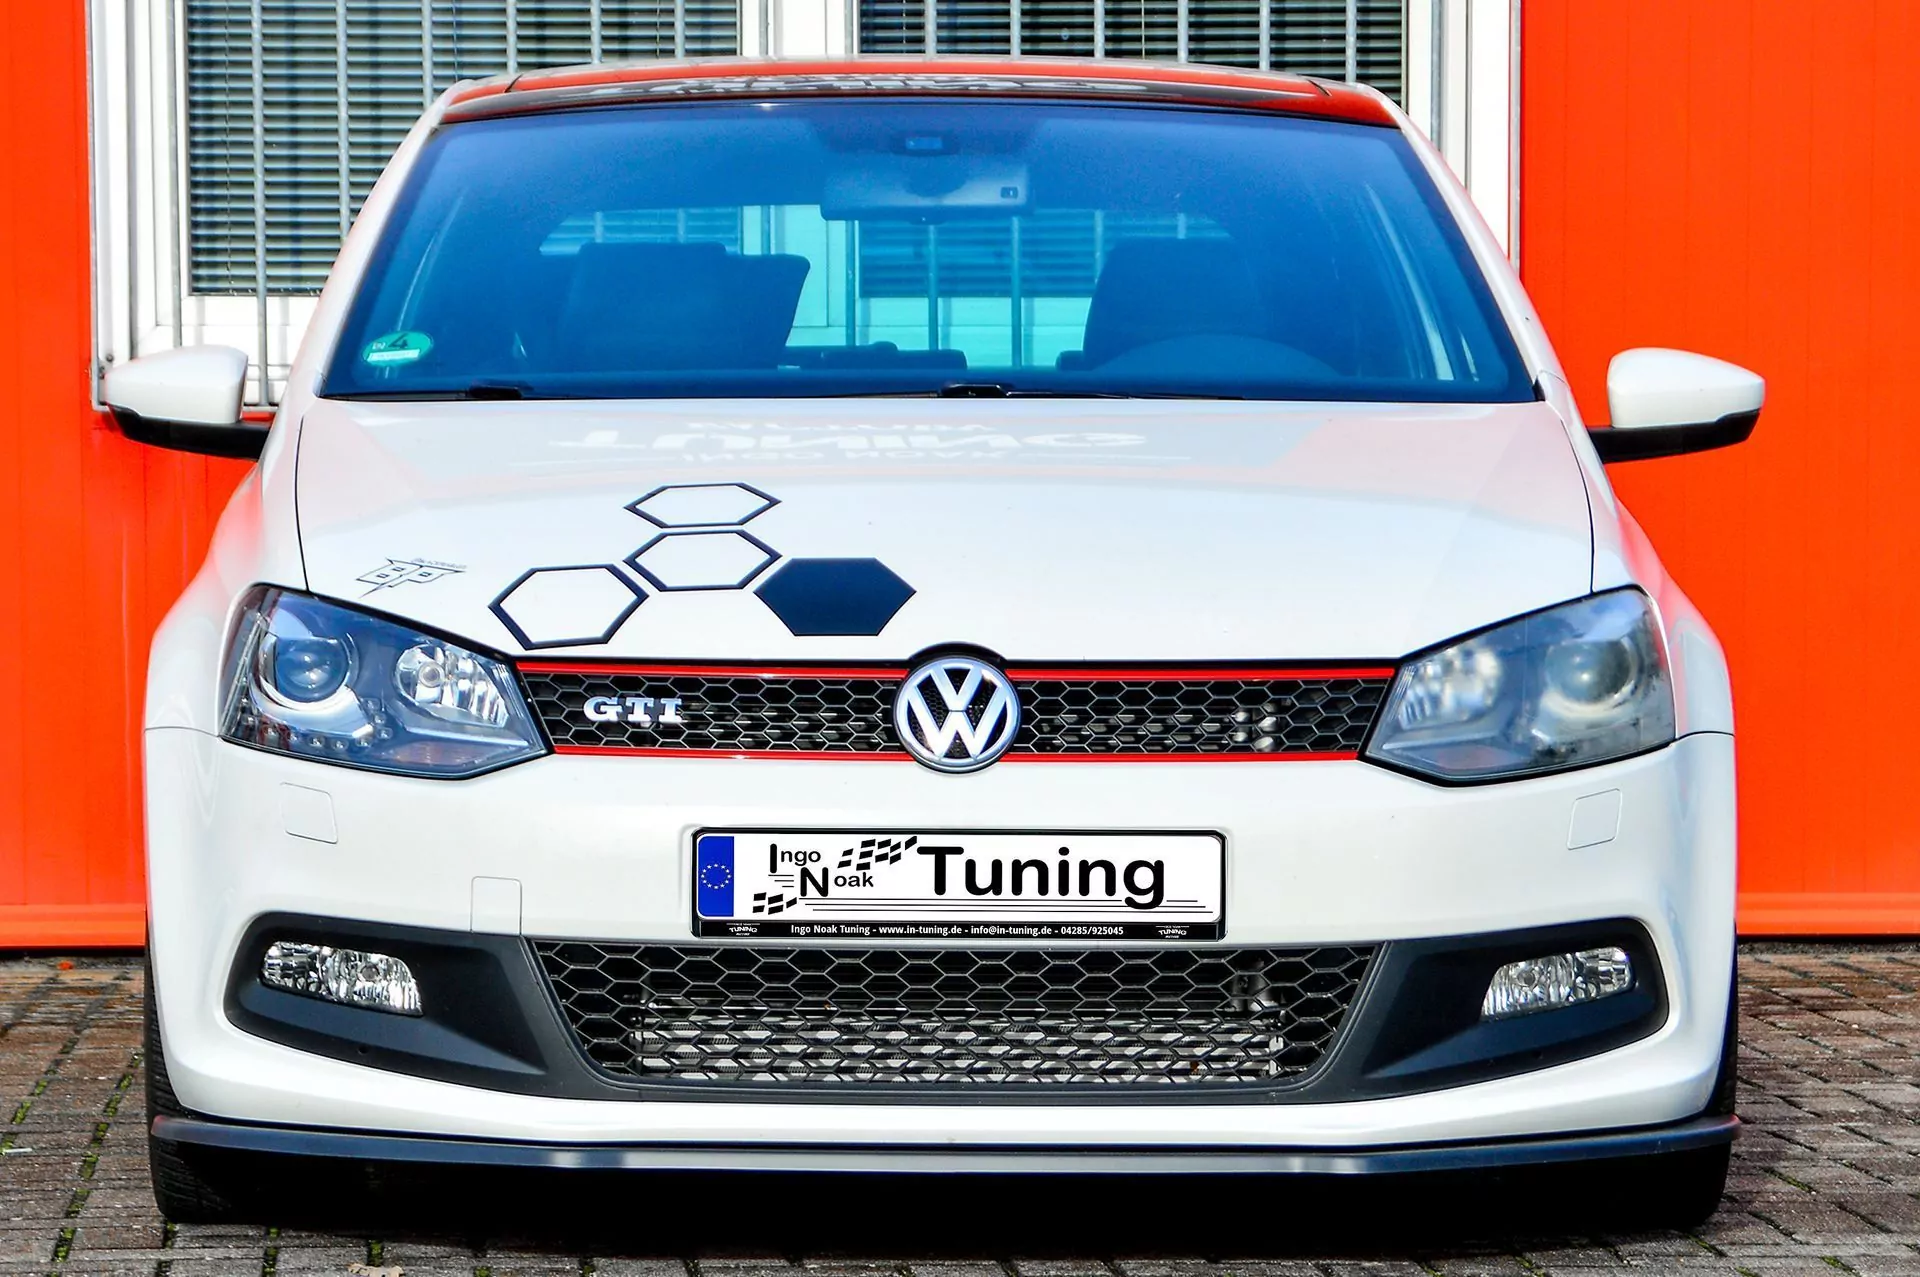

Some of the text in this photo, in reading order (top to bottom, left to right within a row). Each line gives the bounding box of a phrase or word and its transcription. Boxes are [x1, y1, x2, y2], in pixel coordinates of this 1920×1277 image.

[388, 333, 408, 349] 4
[583, 697, 683, 722] GTI
[908, 667, 1009, 759] VW
[770, 843, 821, 873] Ingo
[800, 867, 874, 897] Noak
[917, 846, 1164, 910] Tuning
[791, 925, 811, 936] Ingo
[813, 925, 837, 934] Noak
[840, 925, 870, 936] Tuning
[878, 925, 962, 936] www.in-tuning.de
[970, 925, 1052, 937] info@in-tuning.de
[1061, 926, 1124, 936] 04285/925045
